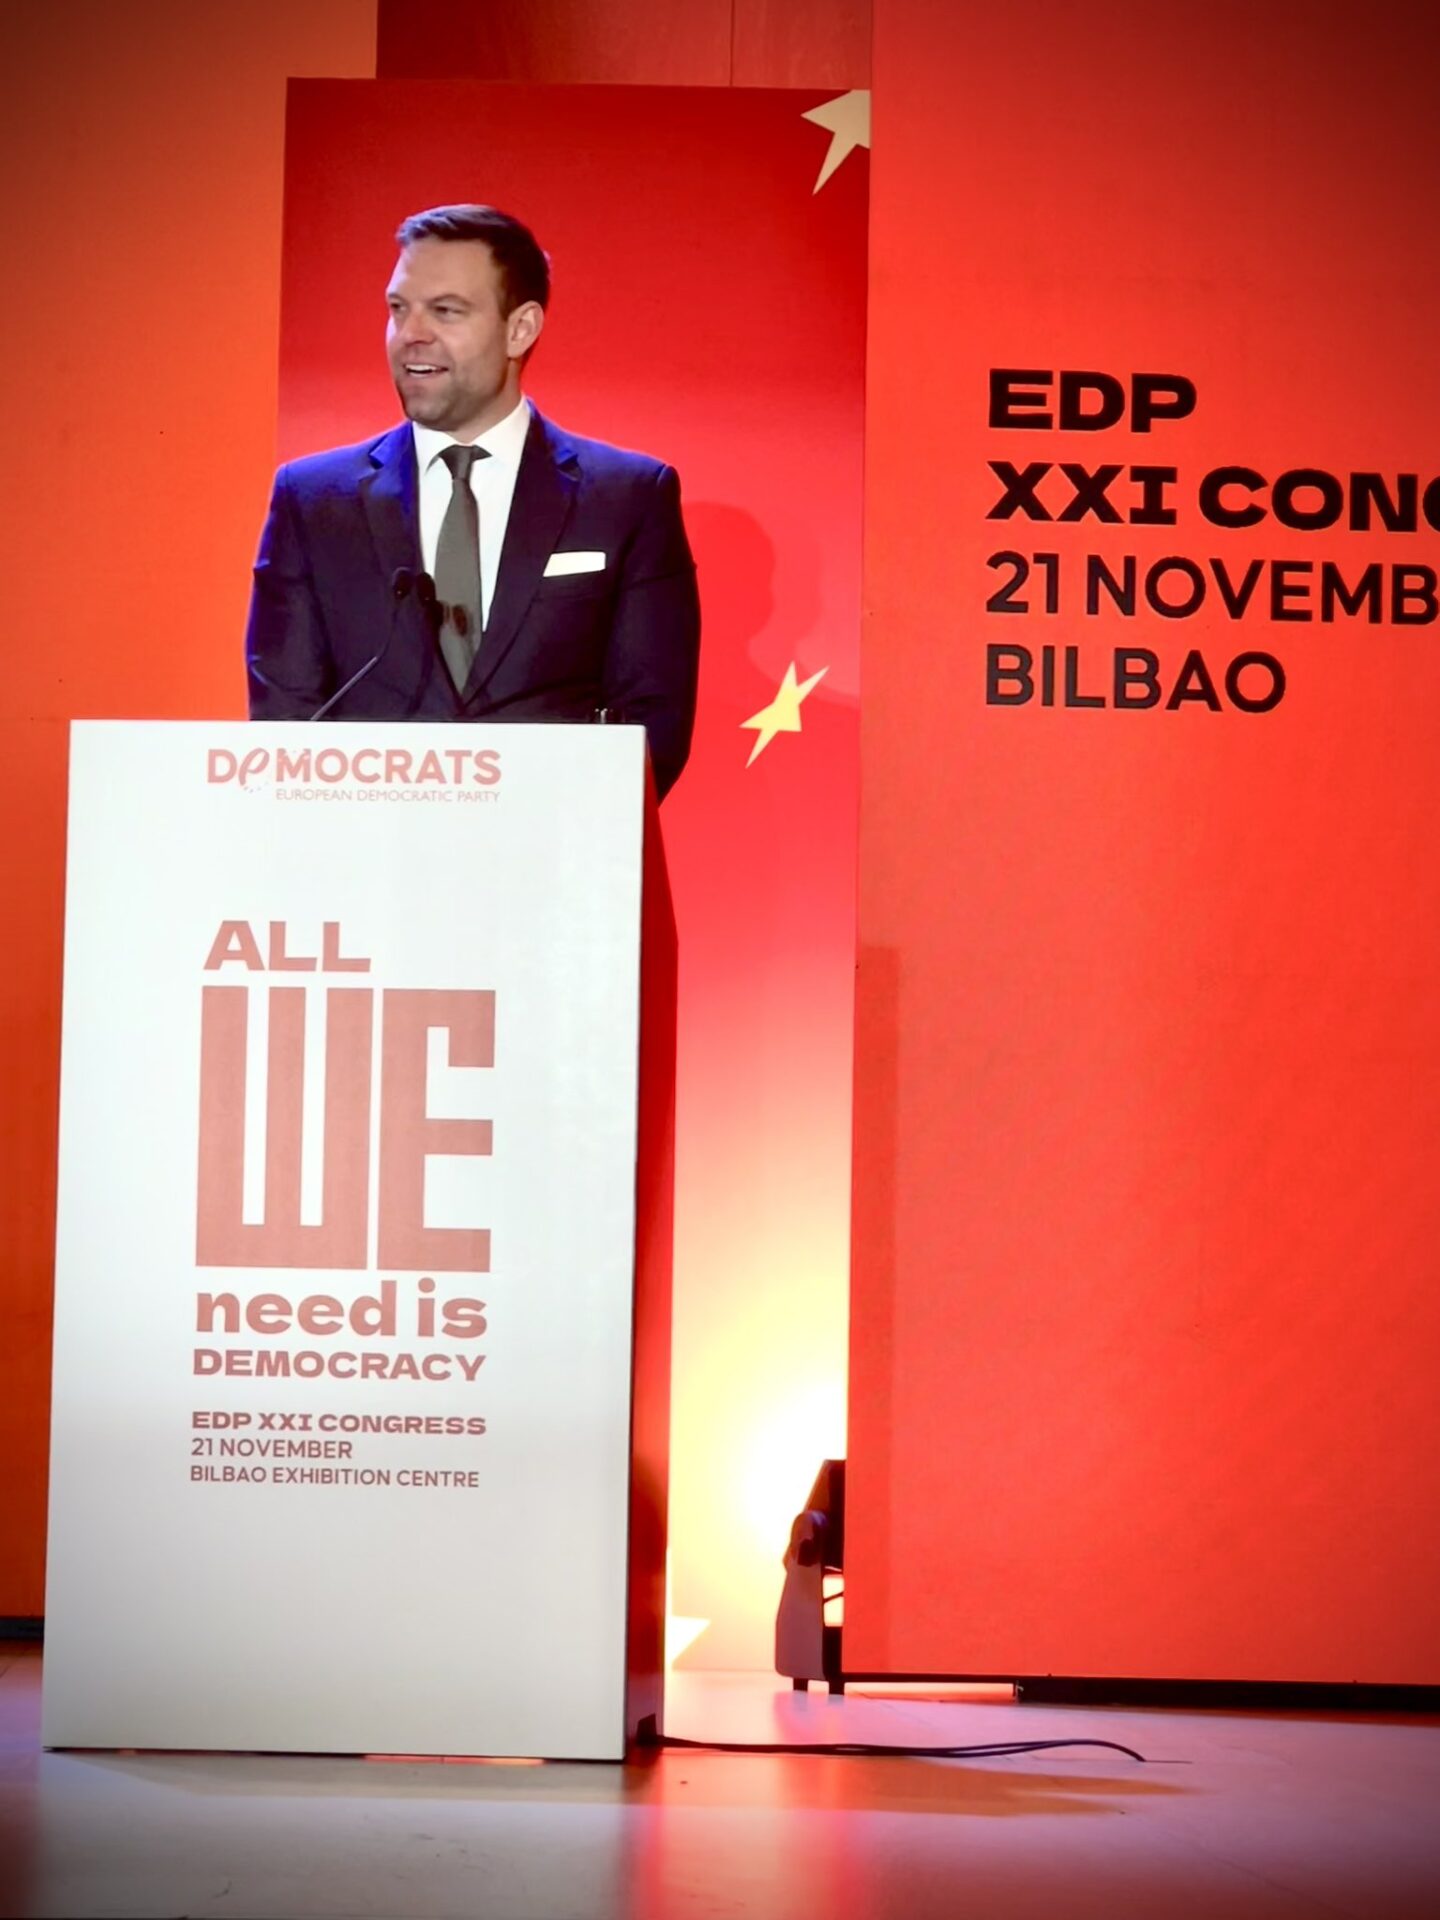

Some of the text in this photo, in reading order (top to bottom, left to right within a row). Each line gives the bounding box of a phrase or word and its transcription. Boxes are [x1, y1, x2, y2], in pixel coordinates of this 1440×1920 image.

[988, 368, 1197, 433] EDP
[985, 460, 1440, 532] XXI CON
[985, 550, 1440, 625] 21 NOVEMB
[985, 643, 1286, 713] BILBAO
[276, 788, 501, 803] EUROPEAN DEMOCRATIC PARTY
[203, 920, 372, 973] ALL
[195, 985, 496, 1273] WE
[196, 1277, 488, 1339] need is
[193, 1348, 487, 1382] DEMOCRACY
[191, 1438, 353, 1460] 21 NOVEMBER
[192, 1411, 487, 1436] EDP XXI CONGRESS
[190, 1466, 480, 1488] BILBAO EXHIBITION CENTRE
